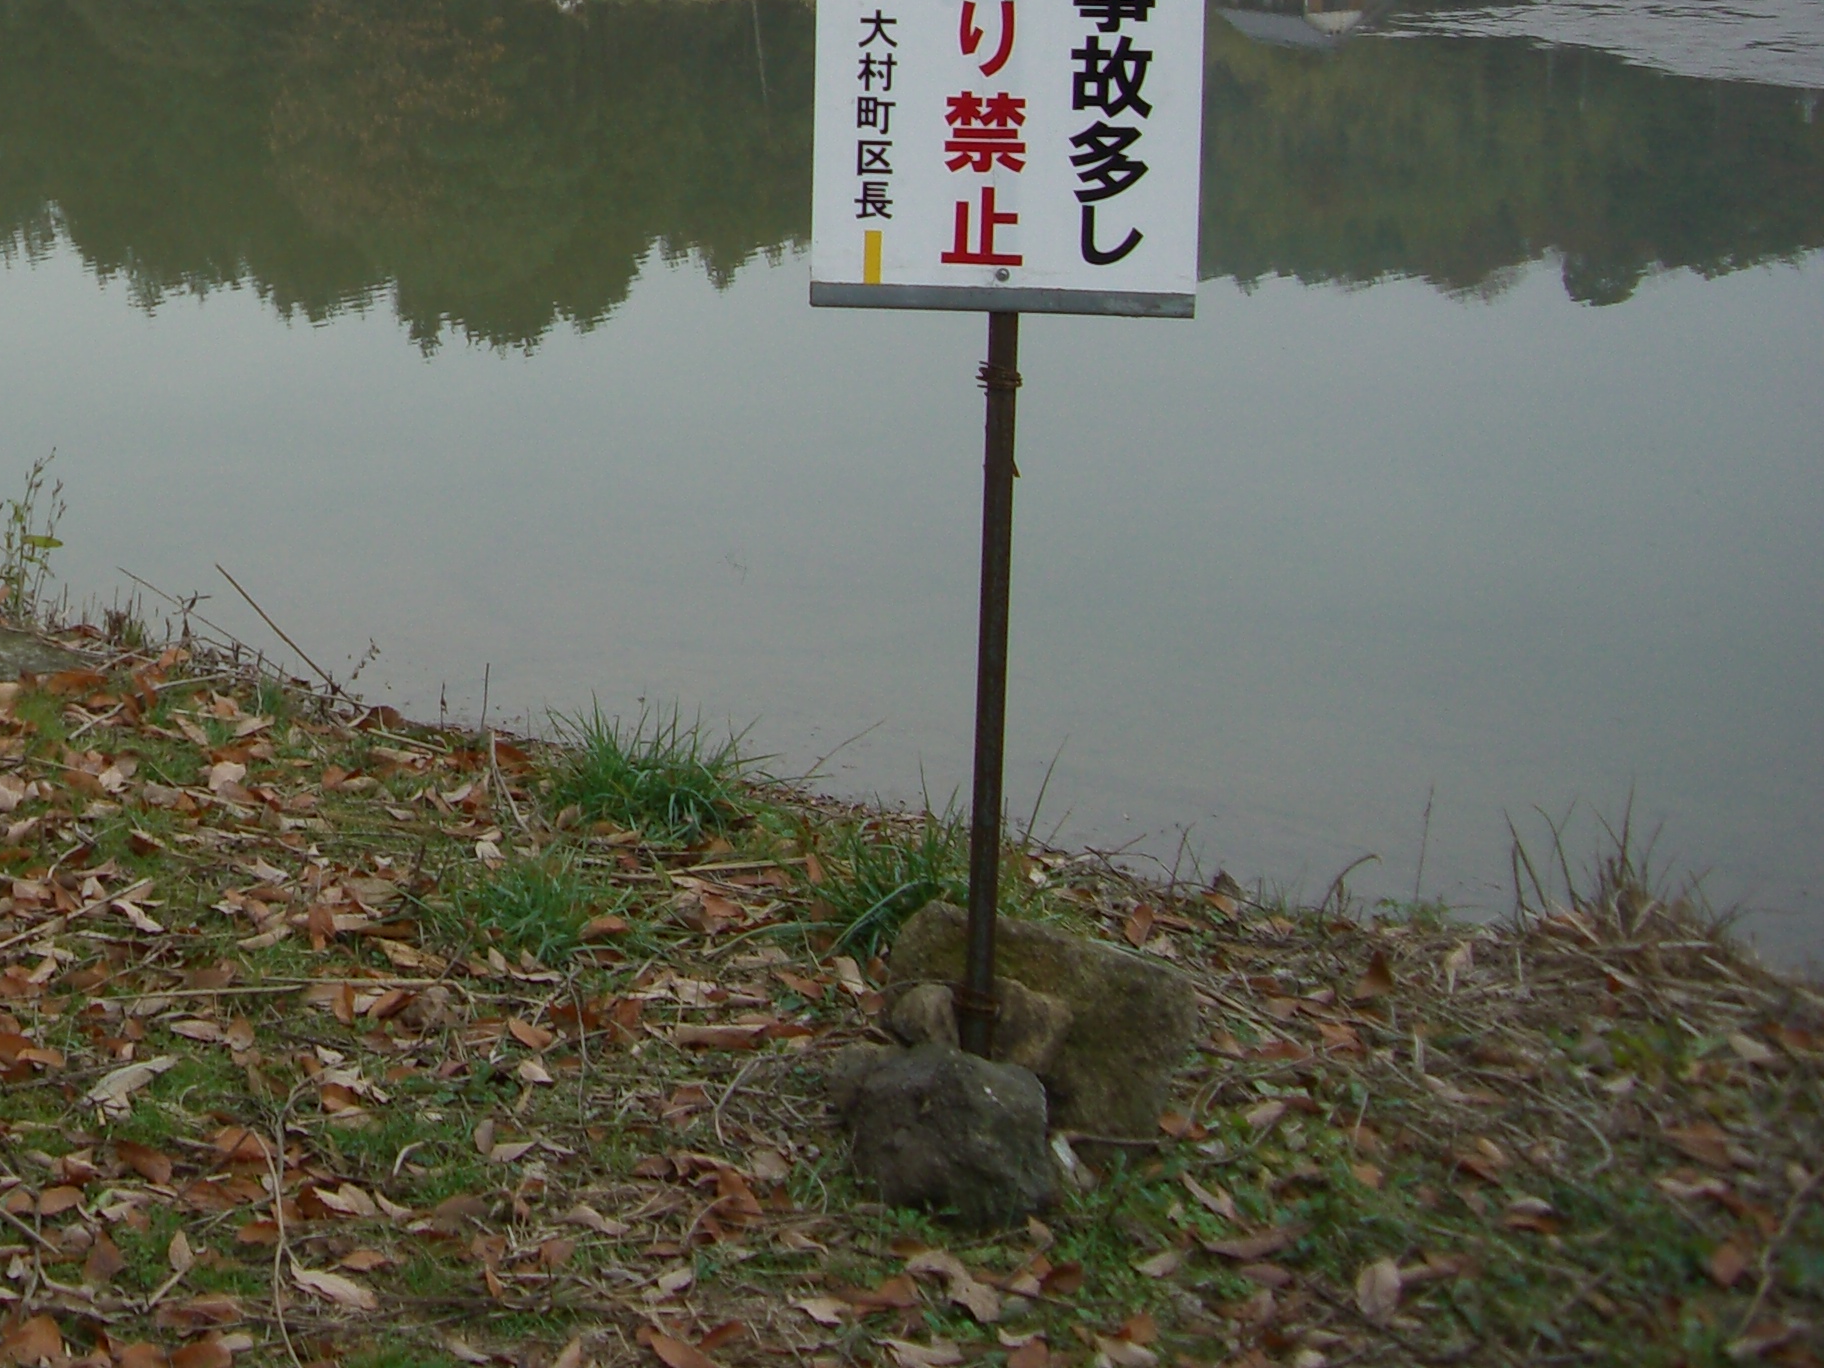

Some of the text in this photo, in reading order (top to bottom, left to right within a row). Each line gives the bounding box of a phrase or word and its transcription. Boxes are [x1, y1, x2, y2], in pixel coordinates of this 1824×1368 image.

[854, 9, 898, 220] 大村町区長
